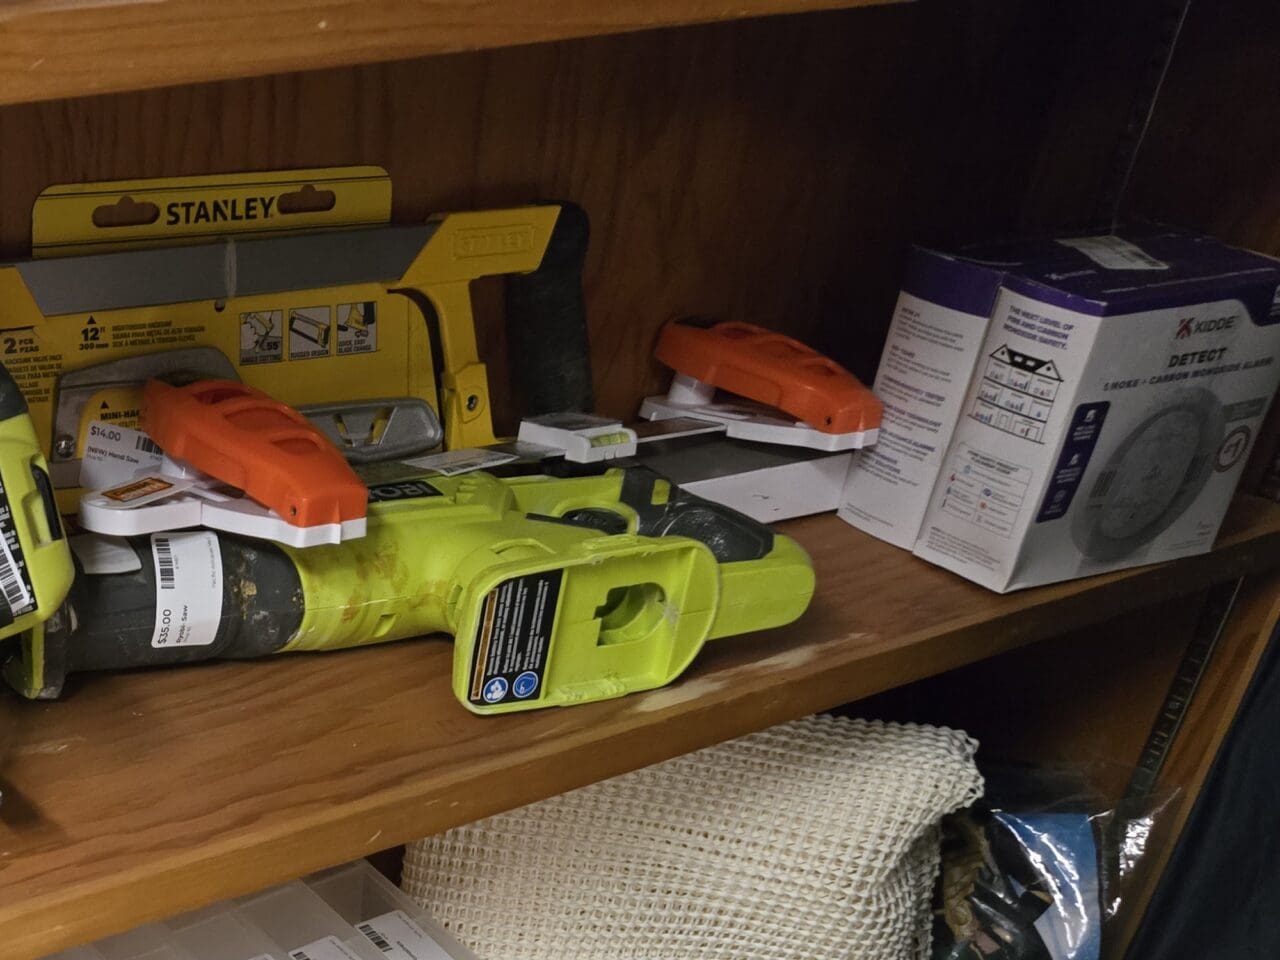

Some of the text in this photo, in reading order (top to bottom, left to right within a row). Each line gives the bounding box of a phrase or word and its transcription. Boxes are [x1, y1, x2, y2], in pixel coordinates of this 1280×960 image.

[167, 196, 275, 226] STANLEY
[1194, 316, 1236, 333] KIDDE
[4, 337, 18, 354] 2
[19, 345, 40, 353] PZAS
[79, 343, 94, 351] 300
[1168, 347, 1228, 368] DETECT
[1104, 379, 1140, 391] SMOKE
[1149, 371, 1190, 385] CARBON
[1191, 361, 1240, 378] MONOXIDE
[1241, 356, 1275, 370] ALARM
[90, 426, 121, 442] $14.00
[87, 446, 107, 458] (NEW)
[108, 451, 125, 462] Hand
[125, 453, 139, 464] Saw
[368, 483, 434, 499] OBI
[181, 604, 189, 622] Saw
[158, 609, 172, 645] $35.00
